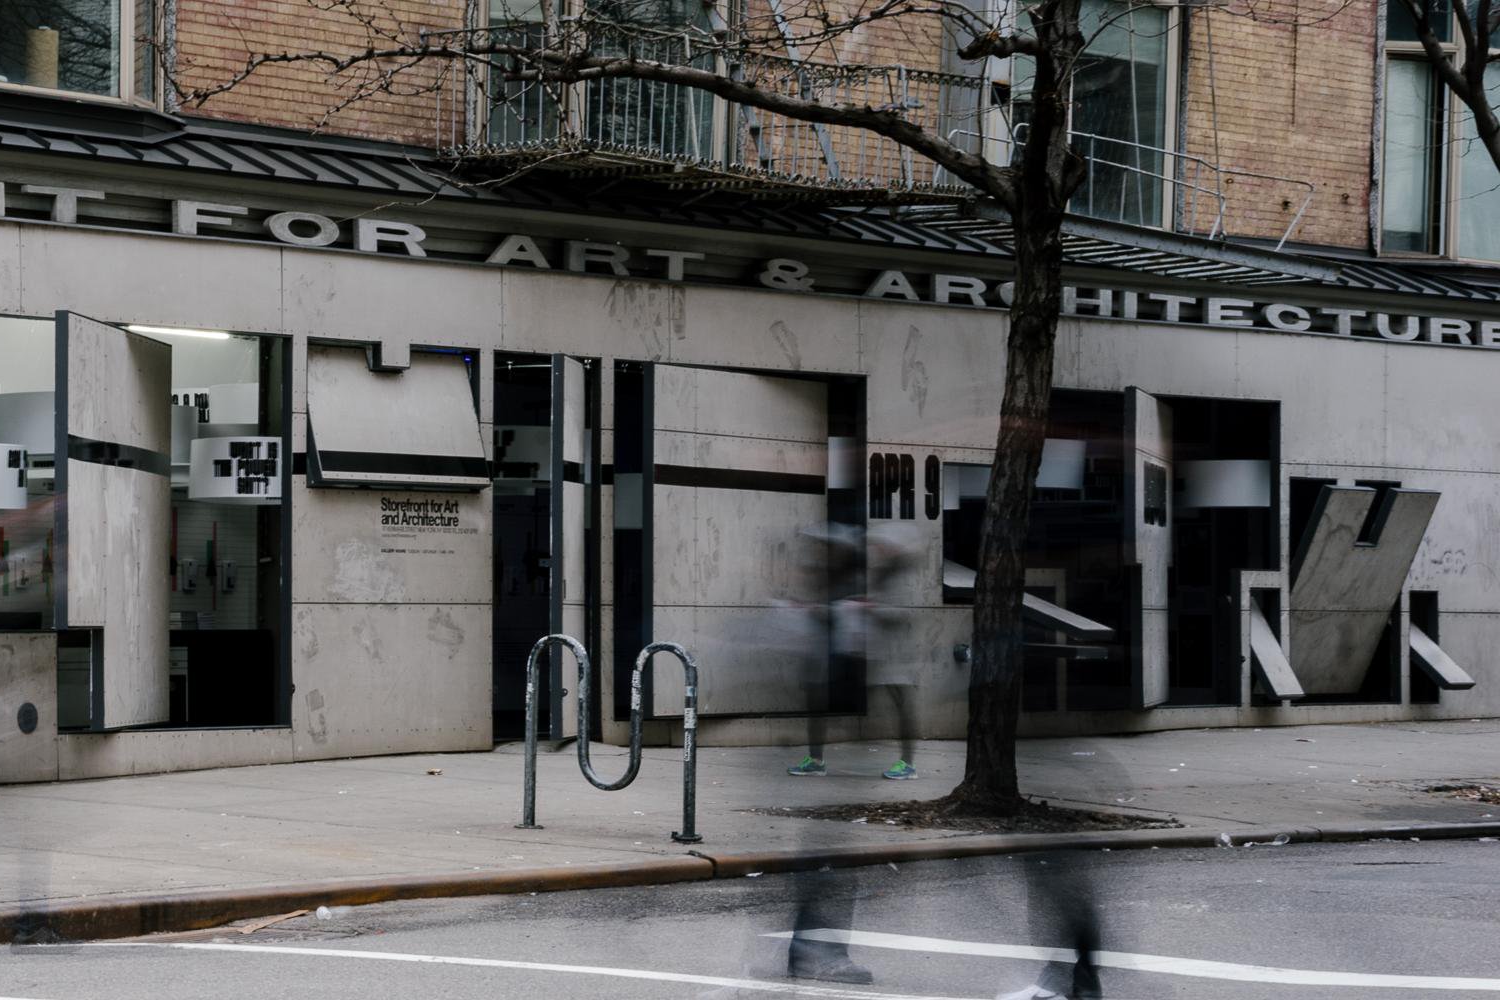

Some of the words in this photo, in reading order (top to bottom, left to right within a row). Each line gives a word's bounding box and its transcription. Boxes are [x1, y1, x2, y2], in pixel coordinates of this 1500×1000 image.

[172, 199, 427, 258] FOR
[485, 234, 705, 282] ART
[758, 258, 815, 294] &
[381, 497, 429, 513] Storefront
[430, 499, 444, 513] for
[444, 500, 459, 514] Art
[869, 452, 916, 520] APR
[924, 454, 941, 520] 9
[381, 512, 400, 526] and
[401, 511, 459, 527] Architecture
